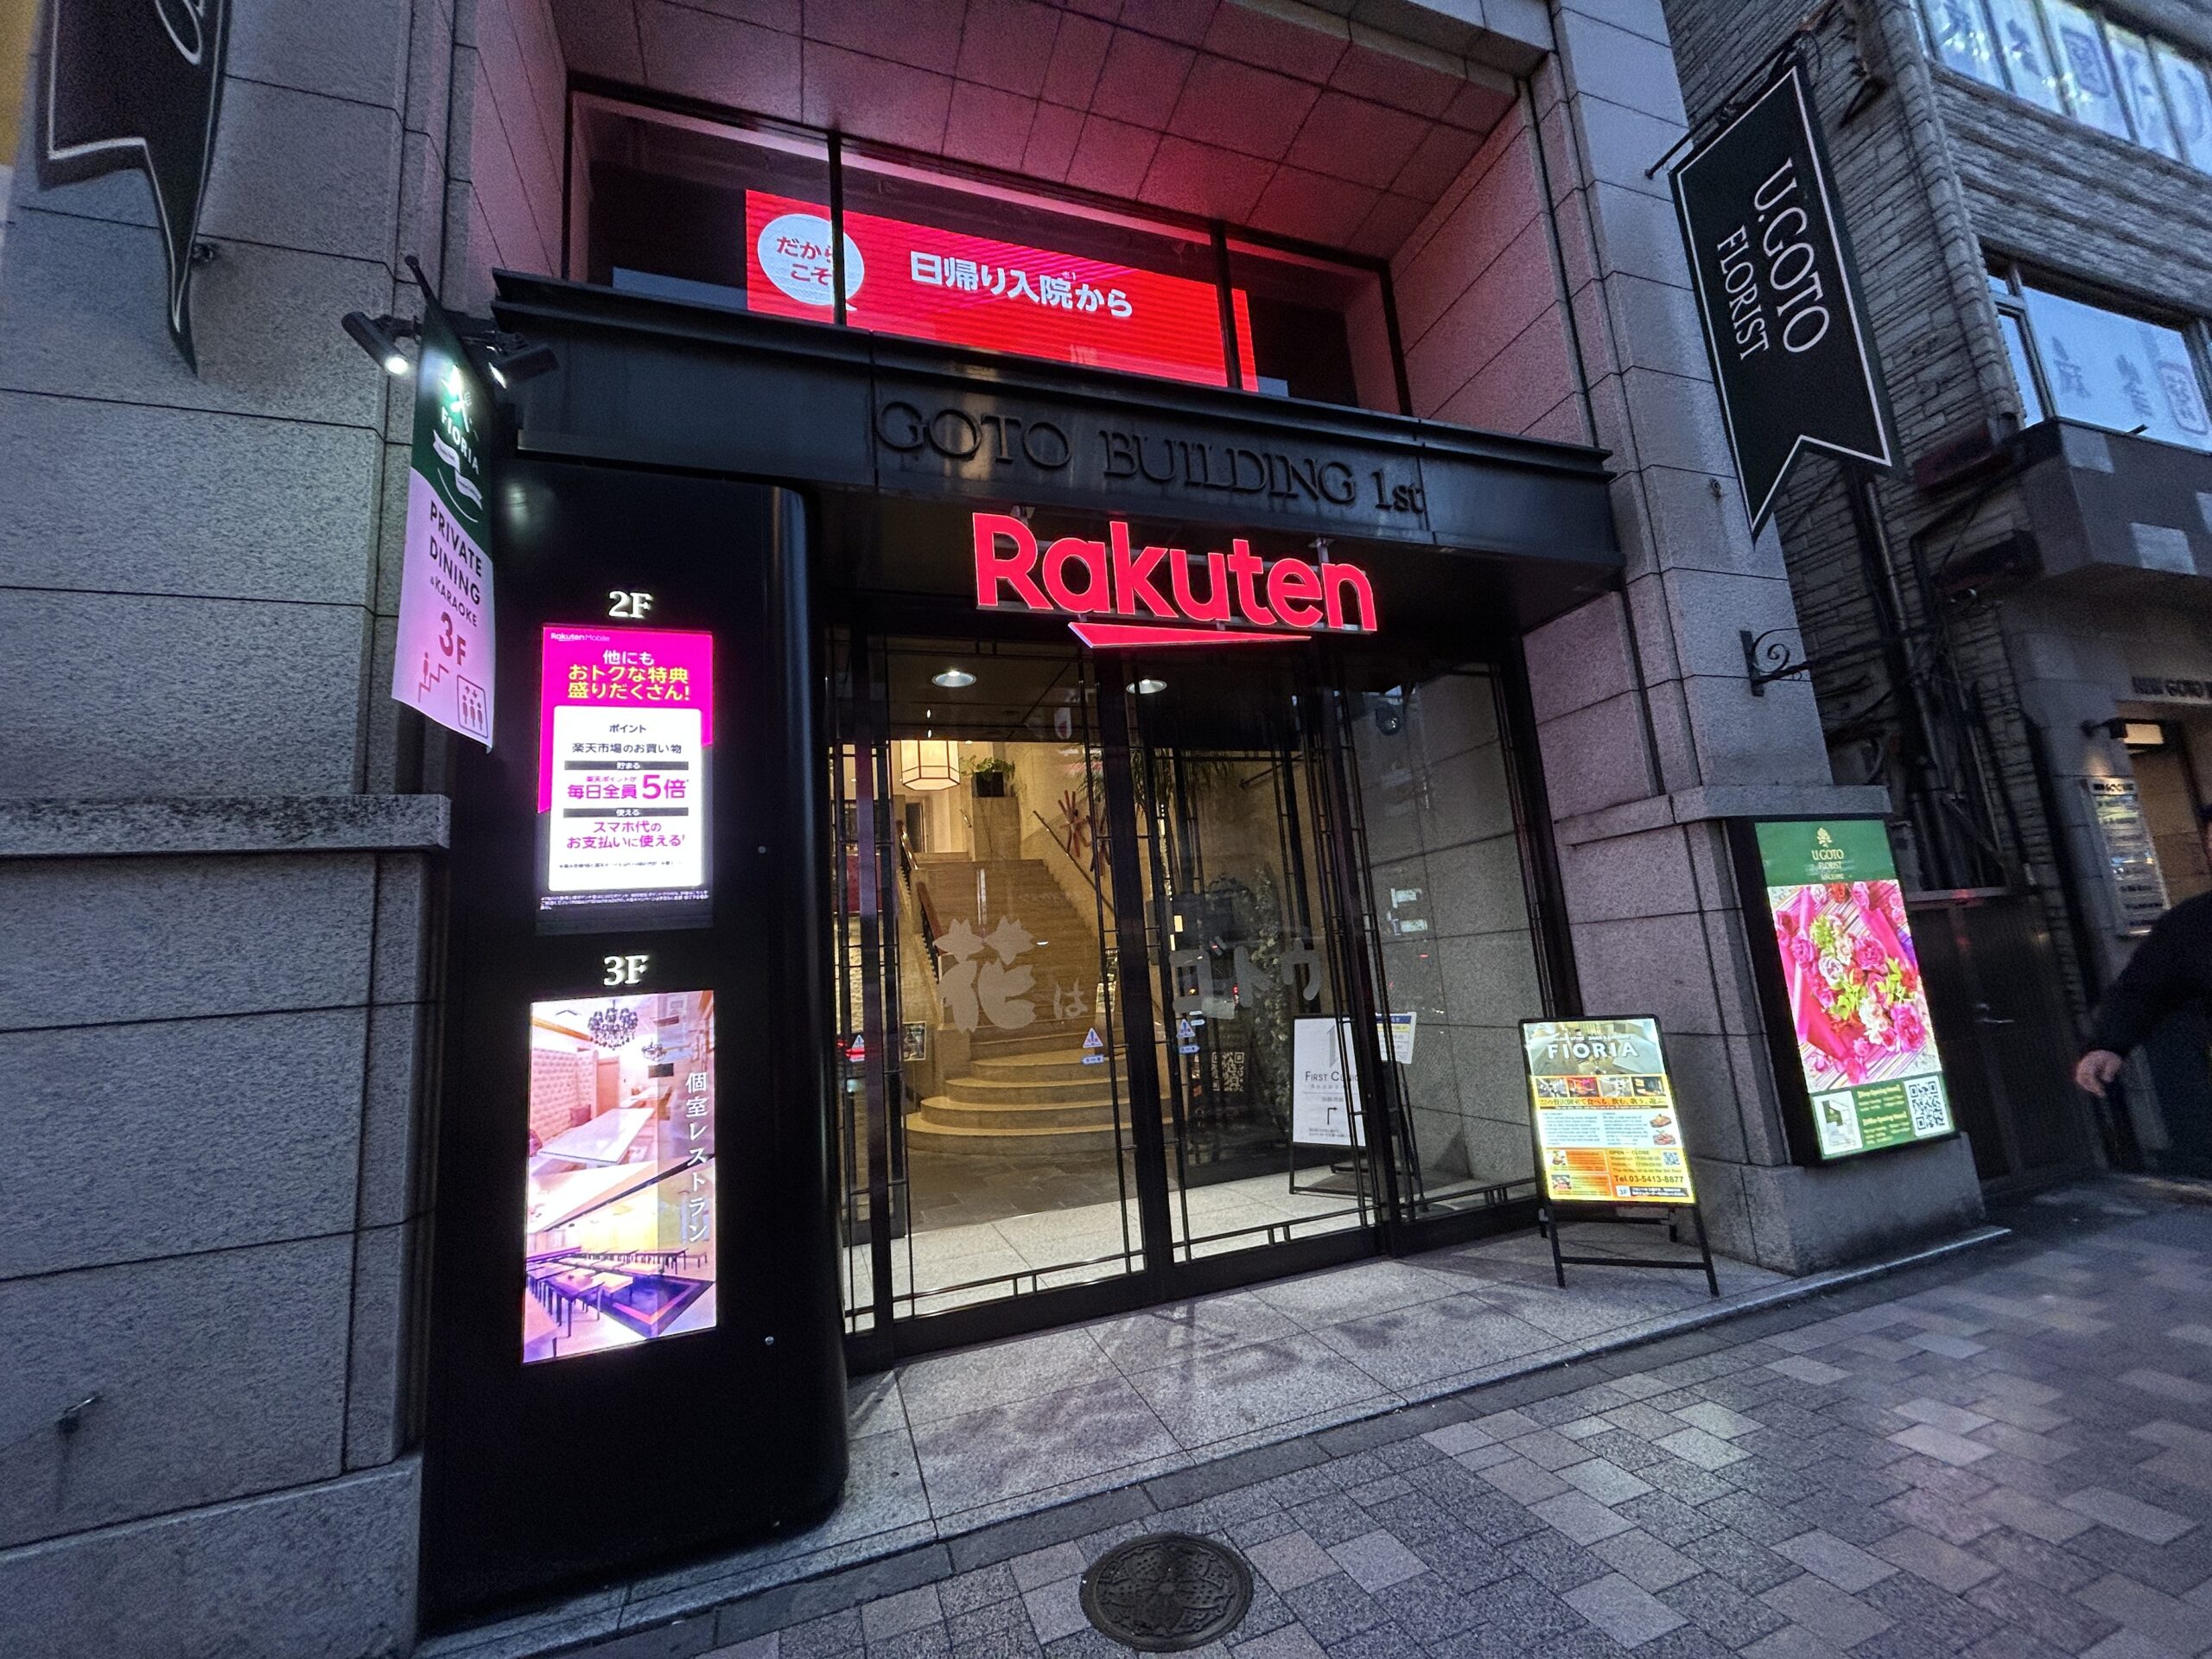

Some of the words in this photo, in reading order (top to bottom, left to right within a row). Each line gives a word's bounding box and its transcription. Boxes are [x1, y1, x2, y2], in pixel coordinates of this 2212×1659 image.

[910, 251, 1133, 318] 日帰り入院から
[1754, 157, 1830, 353] U.GOTO
[1717, 225, 1770, 360] FLORIST
[441, 406, 480, 475] FIORIA
[877, 400, 1072, 468] GOTO
[1099, 430, 1357, 505] BUILDING
[1373, 470, 1425, 515] 1st
[430, 499, 482, 578] PRIVATE
[429, 535, 481, 606] DINING
[972, 512, 1378, 632] Rakuten
[608, 589, 653, 620] 2F
[439, 611, 467, 666] 3F
[603, 650, 655, 665] 他にも
[568, 664, 689, 683] おトクな特典
[572, 742, 682, 754] 楽天市場のお買い物
[609, 724, 646, 734] ポイント
[593, 820, 662, 833] スマホ代の
[603, 955, 649, 986] 3F
[1547, 1041, 1639, 1060] FIORIA
[684, 1071, 709, 1243] 個室レストラン
